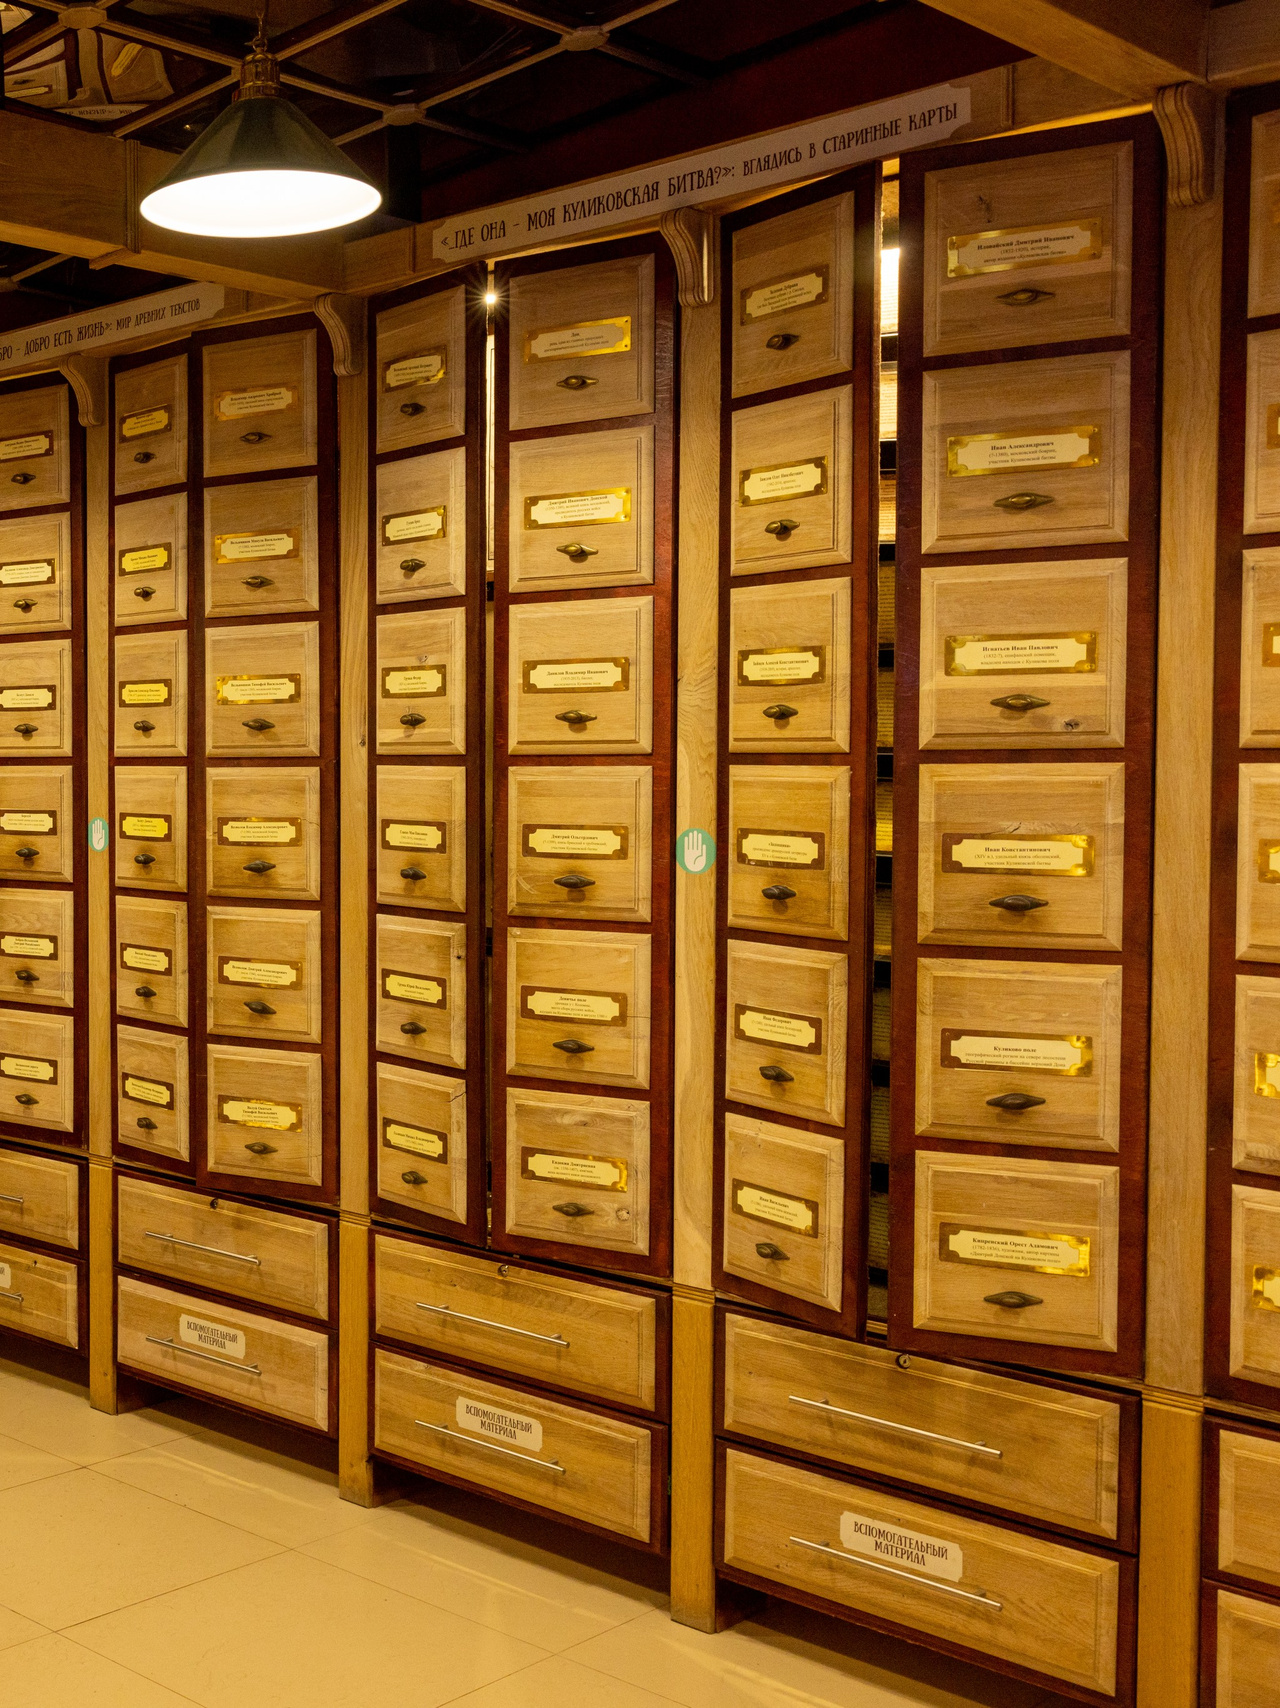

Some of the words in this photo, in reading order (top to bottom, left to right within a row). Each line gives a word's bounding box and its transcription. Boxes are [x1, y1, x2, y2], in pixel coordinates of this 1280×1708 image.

[481, 220, 506, 242] ОНА
[527, 207, 556, 231] МОЯ
[563, 181, 660, 223] КУЛИКОВСКАЯ
[743, 149, 802, 176] ВГЛЯДИСЬ
[809, 142, 817, 159] В
[823, 118, 901, 154] СТАРИННЫЕ
[908, 102, 958, 132] КАРТЫ
[24, 336, 50, 357] ДОБРО
[54, 329, 73, 348] ЕСТЬ
[116, 316, 132, 331] МИР
[135, 306, 166, 327] ДРЕВНИХ
[170, 298, 200, 317] ТЕКСТОВ
[1008, 442, 1054, 450] Александрович
[972, 1237, 1008, 1246] Кипренский
[187, 1321, 238, 1344] ВСПОМОГАТЕЛЬНЫЙ
[198, 1333, 226, 1350] МАТЕРИАЛ
[465, 1404, 532, 1434] ВСПОМОГАТЕЛЬНЫЙ
[480, 1420, 517, 1440] МАТЕРИАЛ
[854, 1521, 948, 1560] ВСПОМОГАТЕЛЬНЫЙ
[874, 1540, 926, 1566] МАТЕРИАЛ
